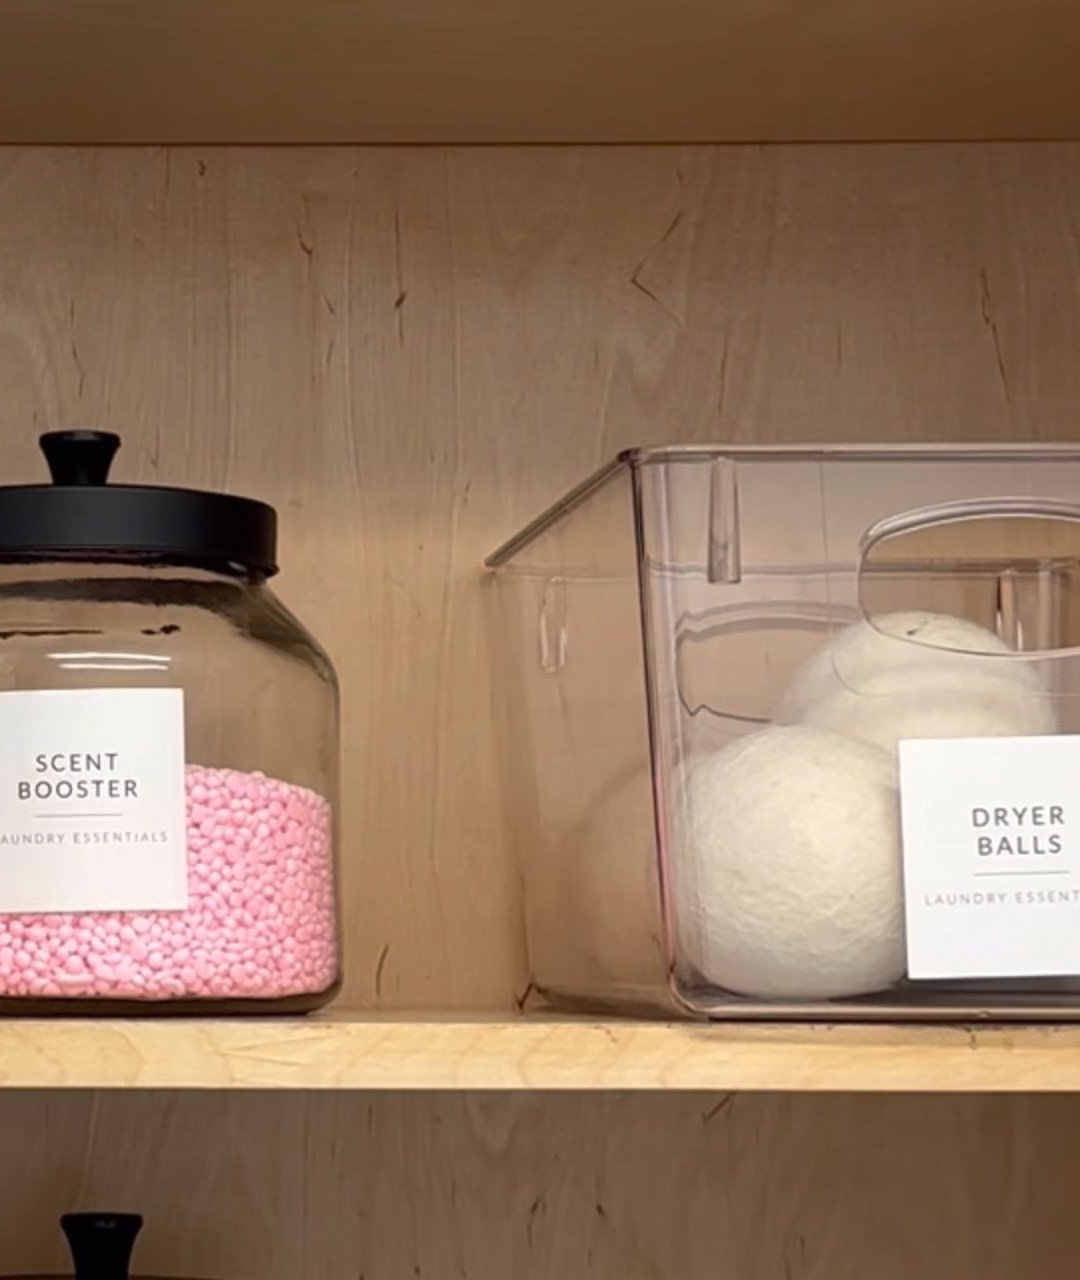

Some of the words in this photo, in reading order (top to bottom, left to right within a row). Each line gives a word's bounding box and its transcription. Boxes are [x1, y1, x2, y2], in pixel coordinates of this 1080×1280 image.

[35, 752, 119, 773] SCENT
[18, 779, 138, 800] BOOSTER
[971, 805, 1065, 828] DRYER
[73, 831, 169, 845] ESSENTIALS
[977, 834, 1063, 856] BALLS
[924, 892, 1007, 907] LAUNDRY
